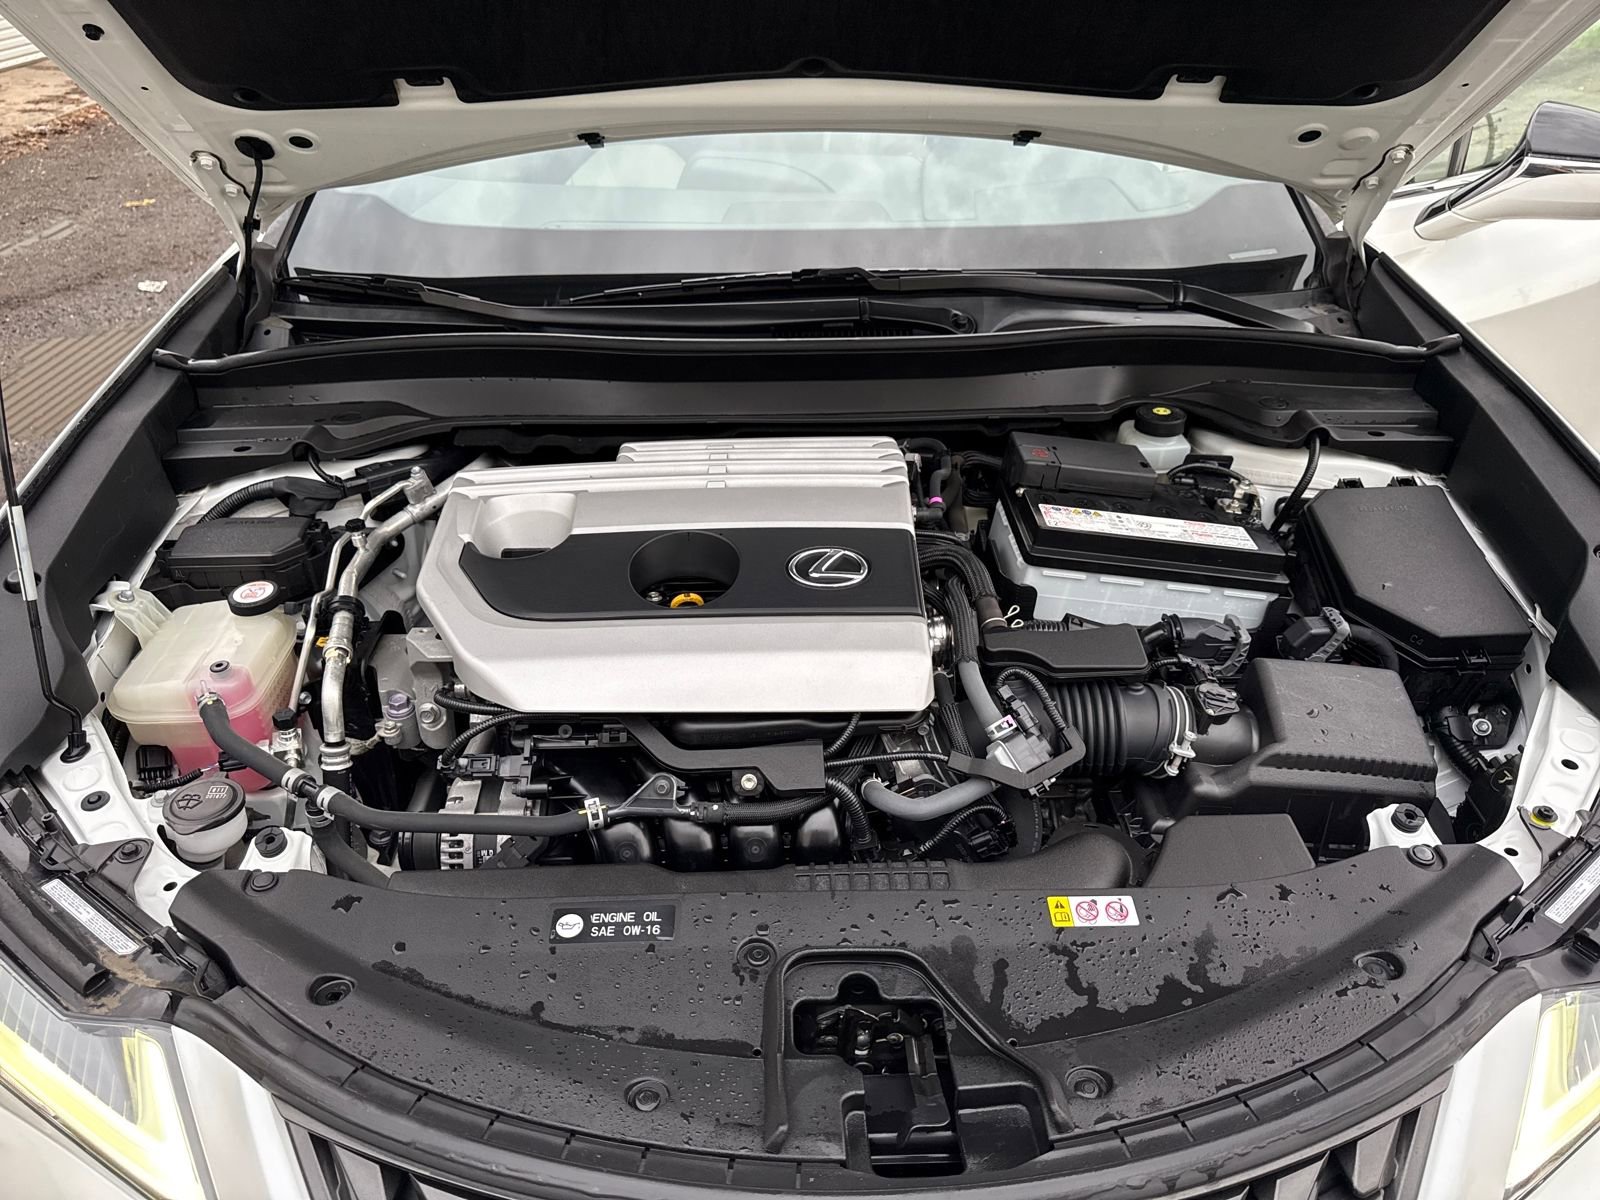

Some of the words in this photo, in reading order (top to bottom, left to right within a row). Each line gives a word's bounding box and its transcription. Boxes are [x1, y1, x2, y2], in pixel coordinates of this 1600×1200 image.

[591, 912, 635, 923] ENGINE
[643, 911, 662, 922] OIL
[590, 926, 615, 937] SAE
[623, 924, 661, 936] 0W-16
